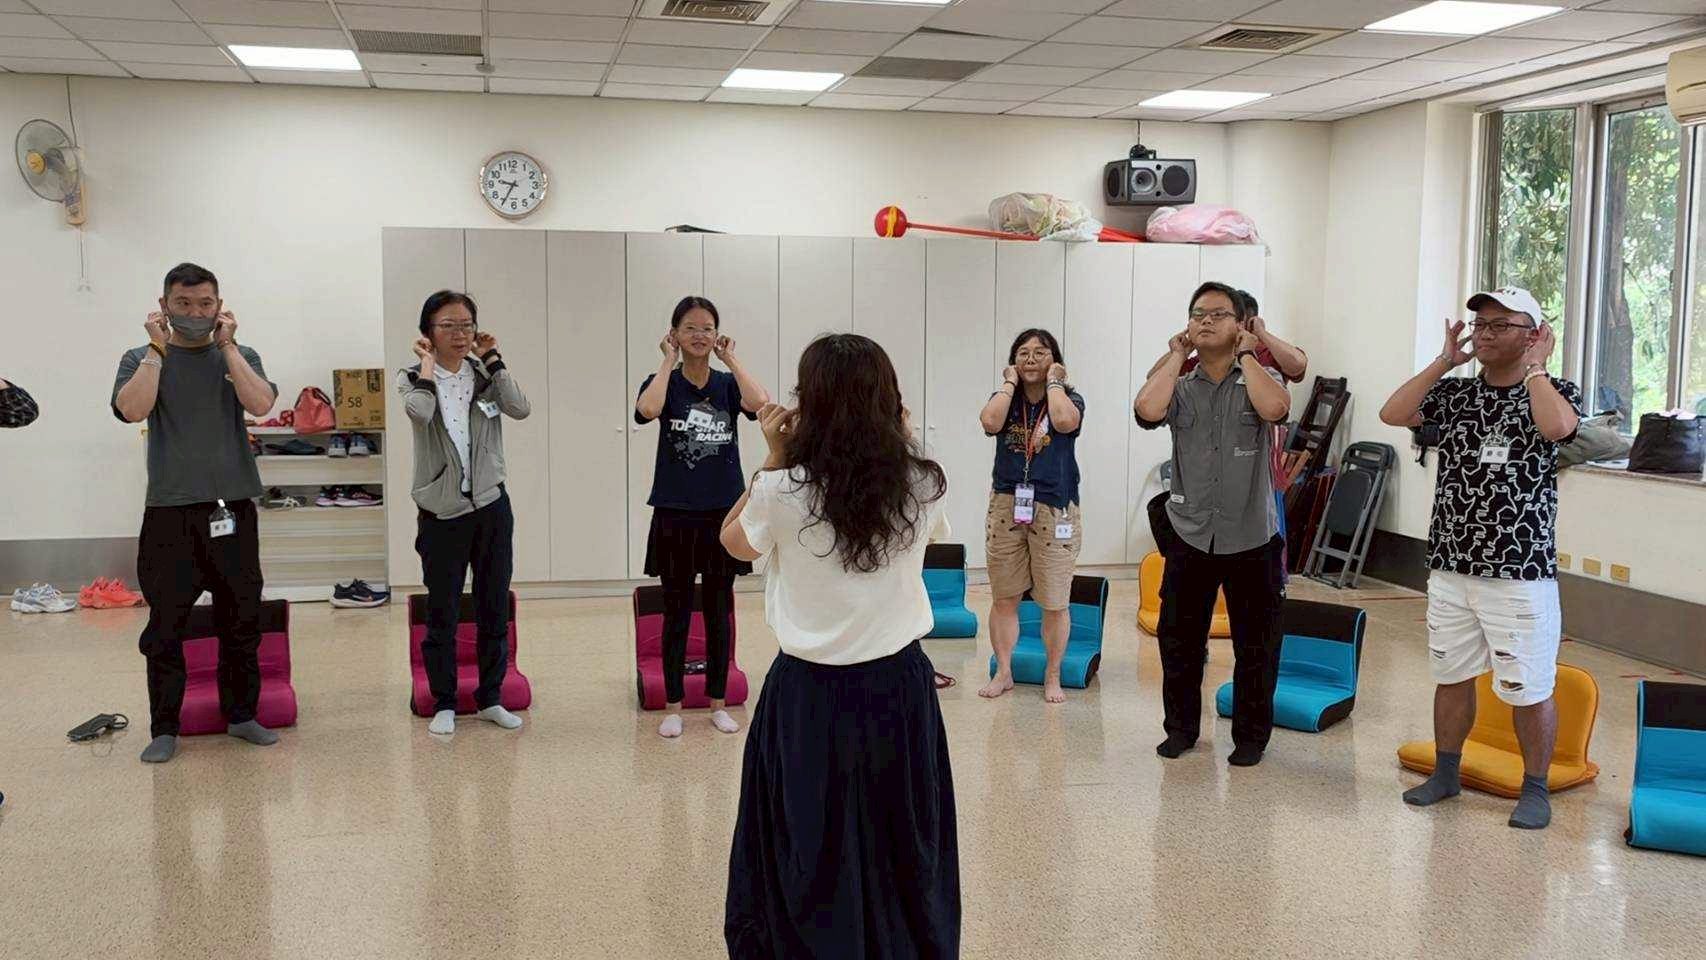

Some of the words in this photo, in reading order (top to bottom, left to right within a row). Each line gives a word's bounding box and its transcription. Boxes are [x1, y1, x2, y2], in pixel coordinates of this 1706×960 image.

[499, 163, 507, 171] 11
[508, 160, 518, 168] 12
[522, 163, 527, 171] 1
[491, 170, 500, 179] 10
[529, 171, 535, 180] 2
[488, 180, 494, 189] 9
[532, 181, 539, 189] 3
[492, 191, 499, 199] 8
[511, 201, 518, 210] 6
[521, 199, 528, 207] 5
[347, 396, 362, 408] 58
